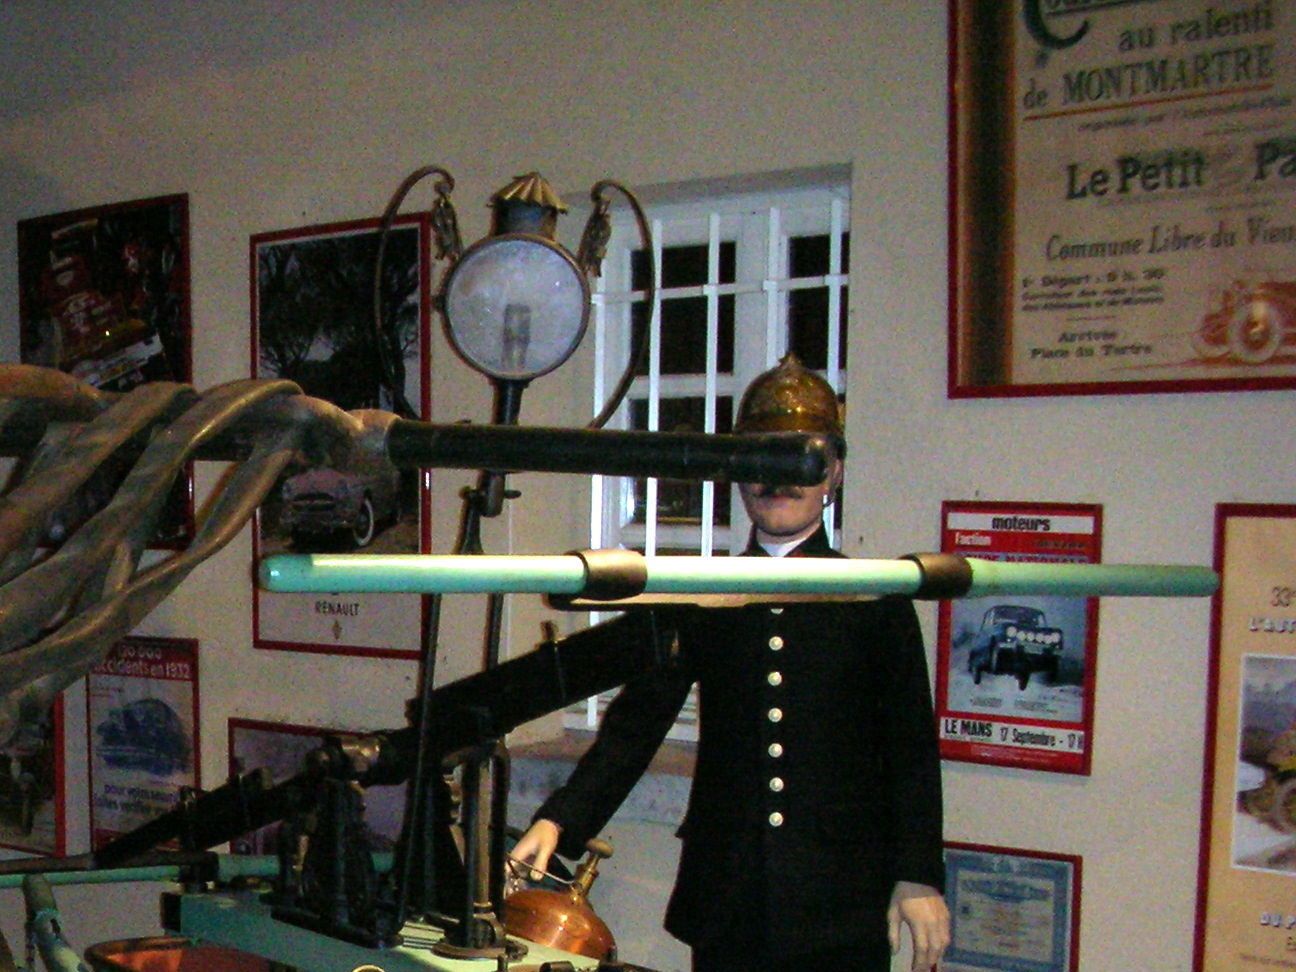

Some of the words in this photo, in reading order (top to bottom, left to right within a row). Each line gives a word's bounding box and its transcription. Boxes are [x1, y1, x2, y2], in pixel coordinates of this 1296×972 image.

[1118, 27, 1155, 51] au
[1022, 78, 1049, 110] de
[1062, 44, 1275, 106] MONTMARTRE
[1065, 163, 1110, 200] Le
[1116, 150, 1205, 194] Petit
[1046, 235, 1143, 261] Commune
[1147, 225, 1205, 255] Libre
[1209, 220, 1236, 249] du
[991, 516, 1052, 533] moteurs
[315, 600, 360, 616] RENAULT
[944, 718, 958, 735] LE
[960, 719, 993, 738] MANS
